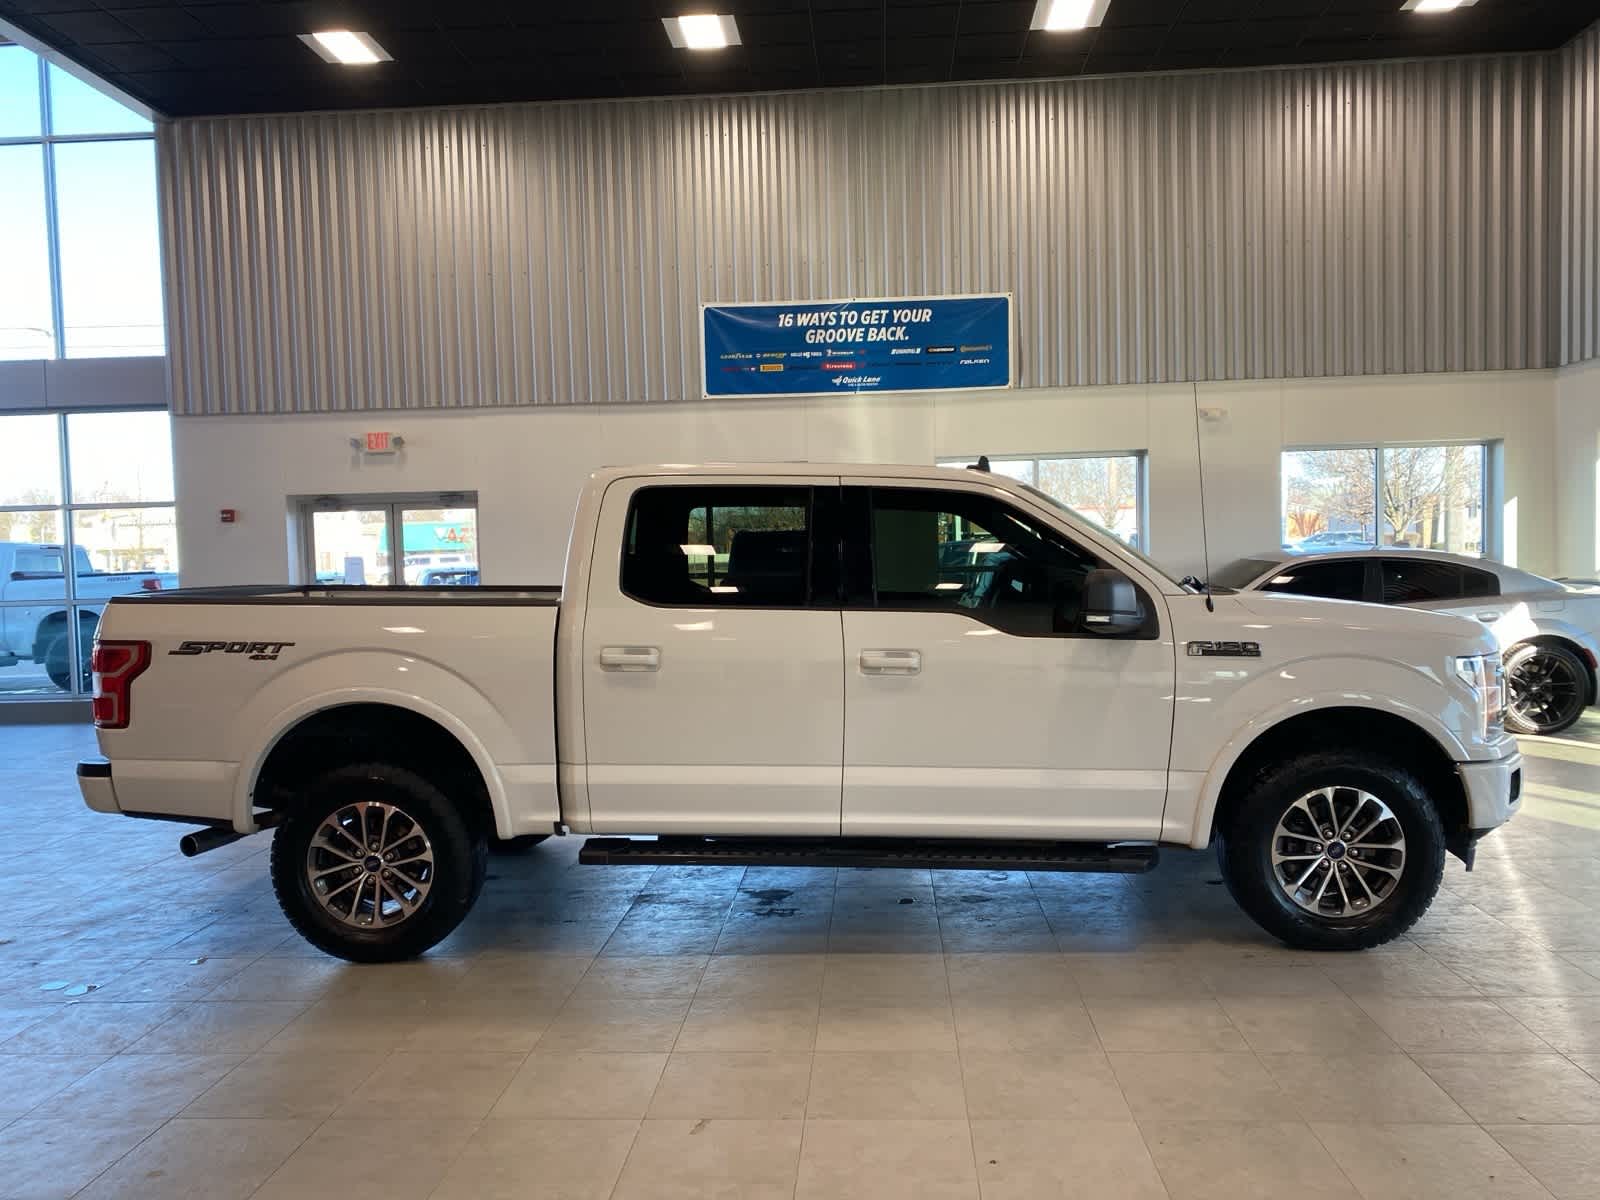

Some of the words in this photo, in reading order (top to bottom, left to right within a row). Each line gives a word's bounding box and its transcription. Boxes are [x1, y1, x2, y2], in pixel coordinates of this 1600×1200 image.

[778, 313, 793, 328] 16
[797, 311, 837, 327] WAYS
[840, 310, 858, 325] TO
[861, 310, 888, 325] GET
[893, 308, 932, 323] YOUR
[805, 327, 865, 344] GROOVE
[867, 326, 910, 342] BACK.
[842, 376, 863, 384] Quick
[863, 375, 881, 383] Lane
[367, 432, 389, 449] EXIT
[168, 641, 296, 656] SPORT
